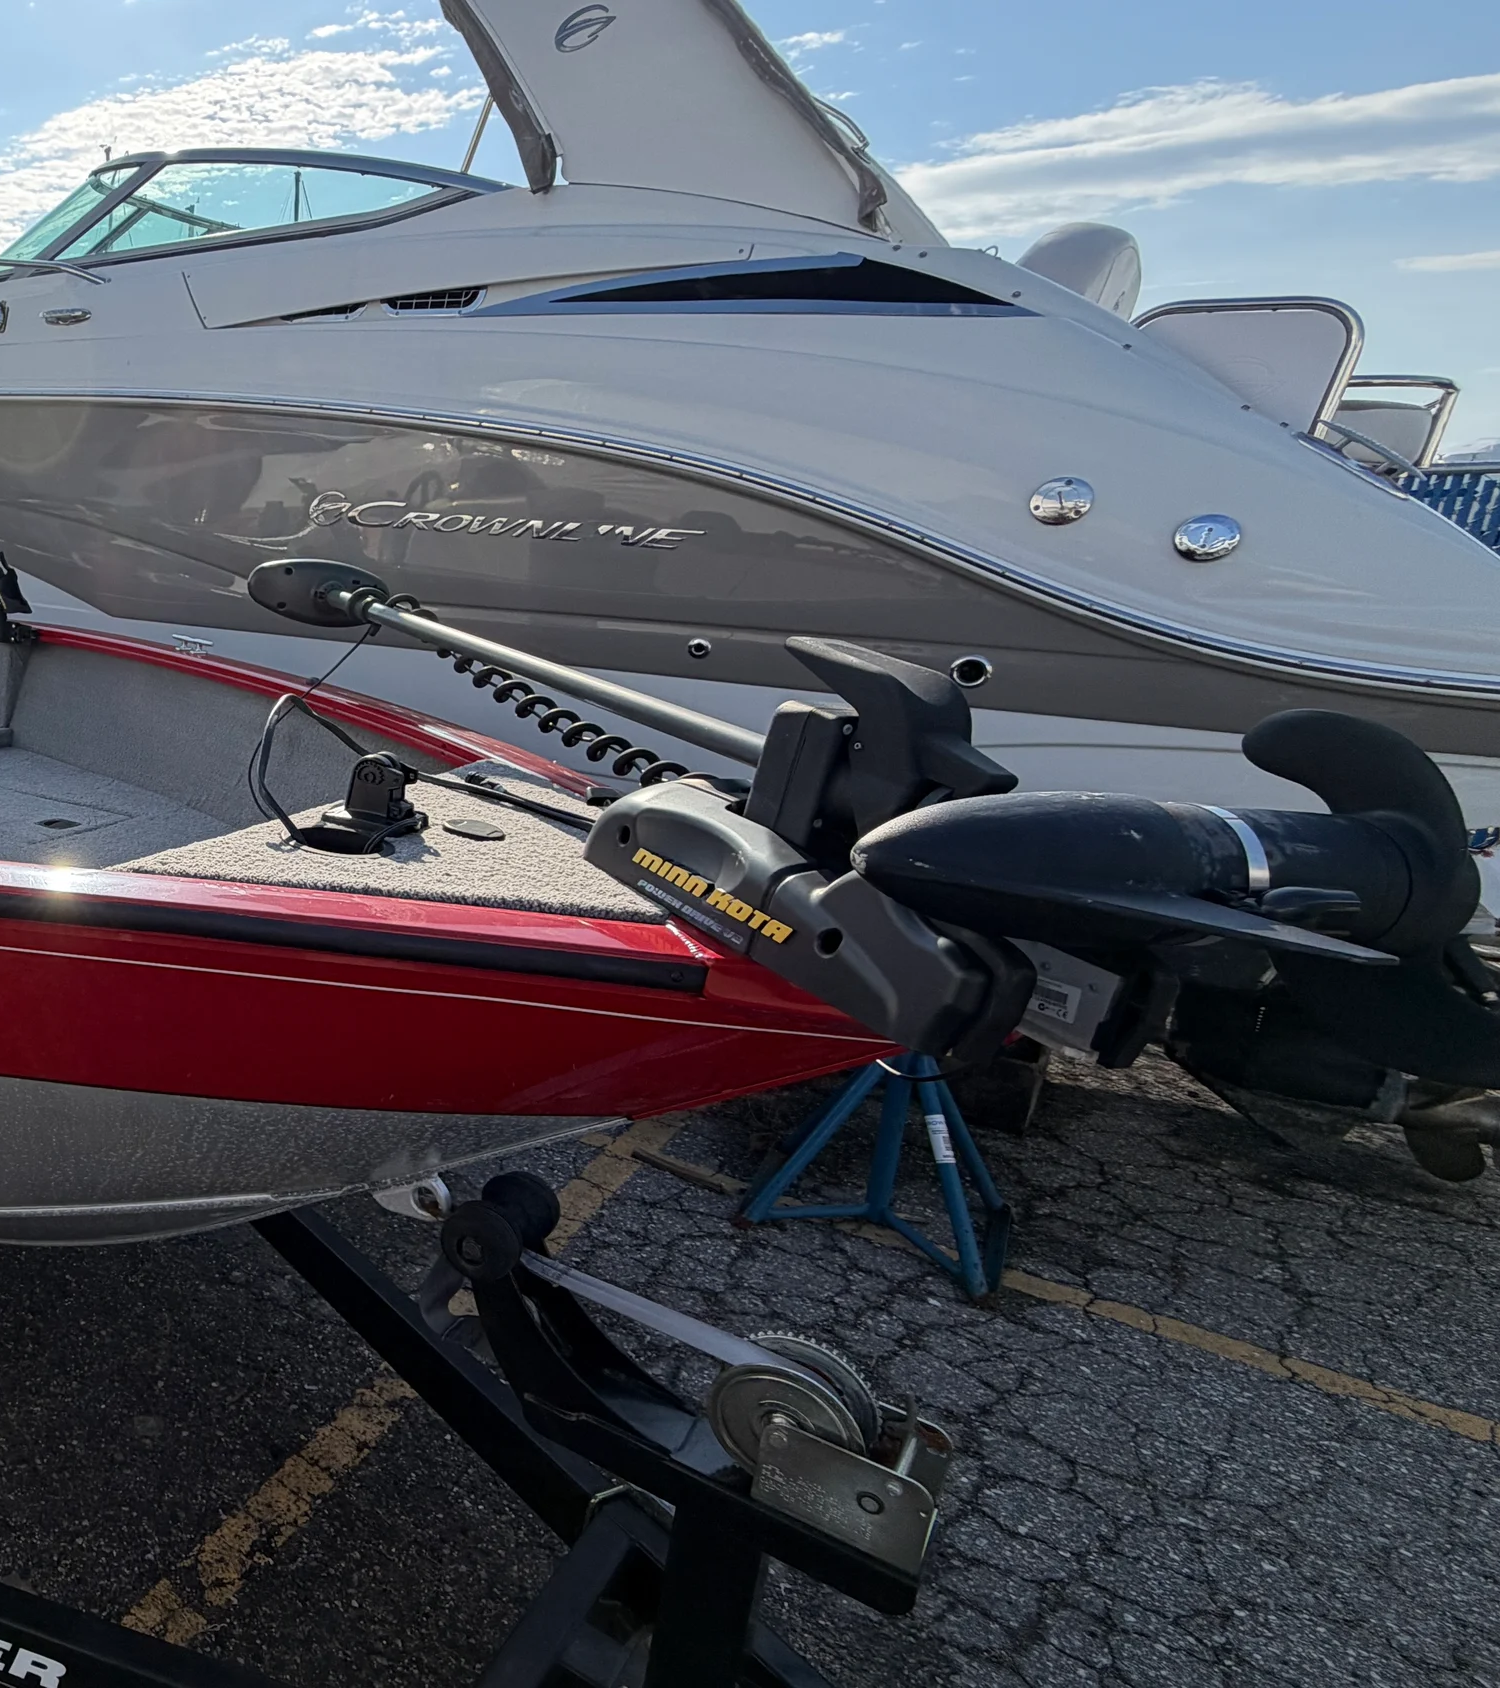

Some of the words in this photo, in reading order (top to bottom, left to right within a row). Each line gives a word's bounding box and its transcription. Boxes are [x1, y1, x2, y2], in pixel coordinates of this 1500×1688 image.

[637, 879, 683, 910] POWER
[681, 905, 724, 933] DRIVE
[705, 888, 793, 944] KOTA
